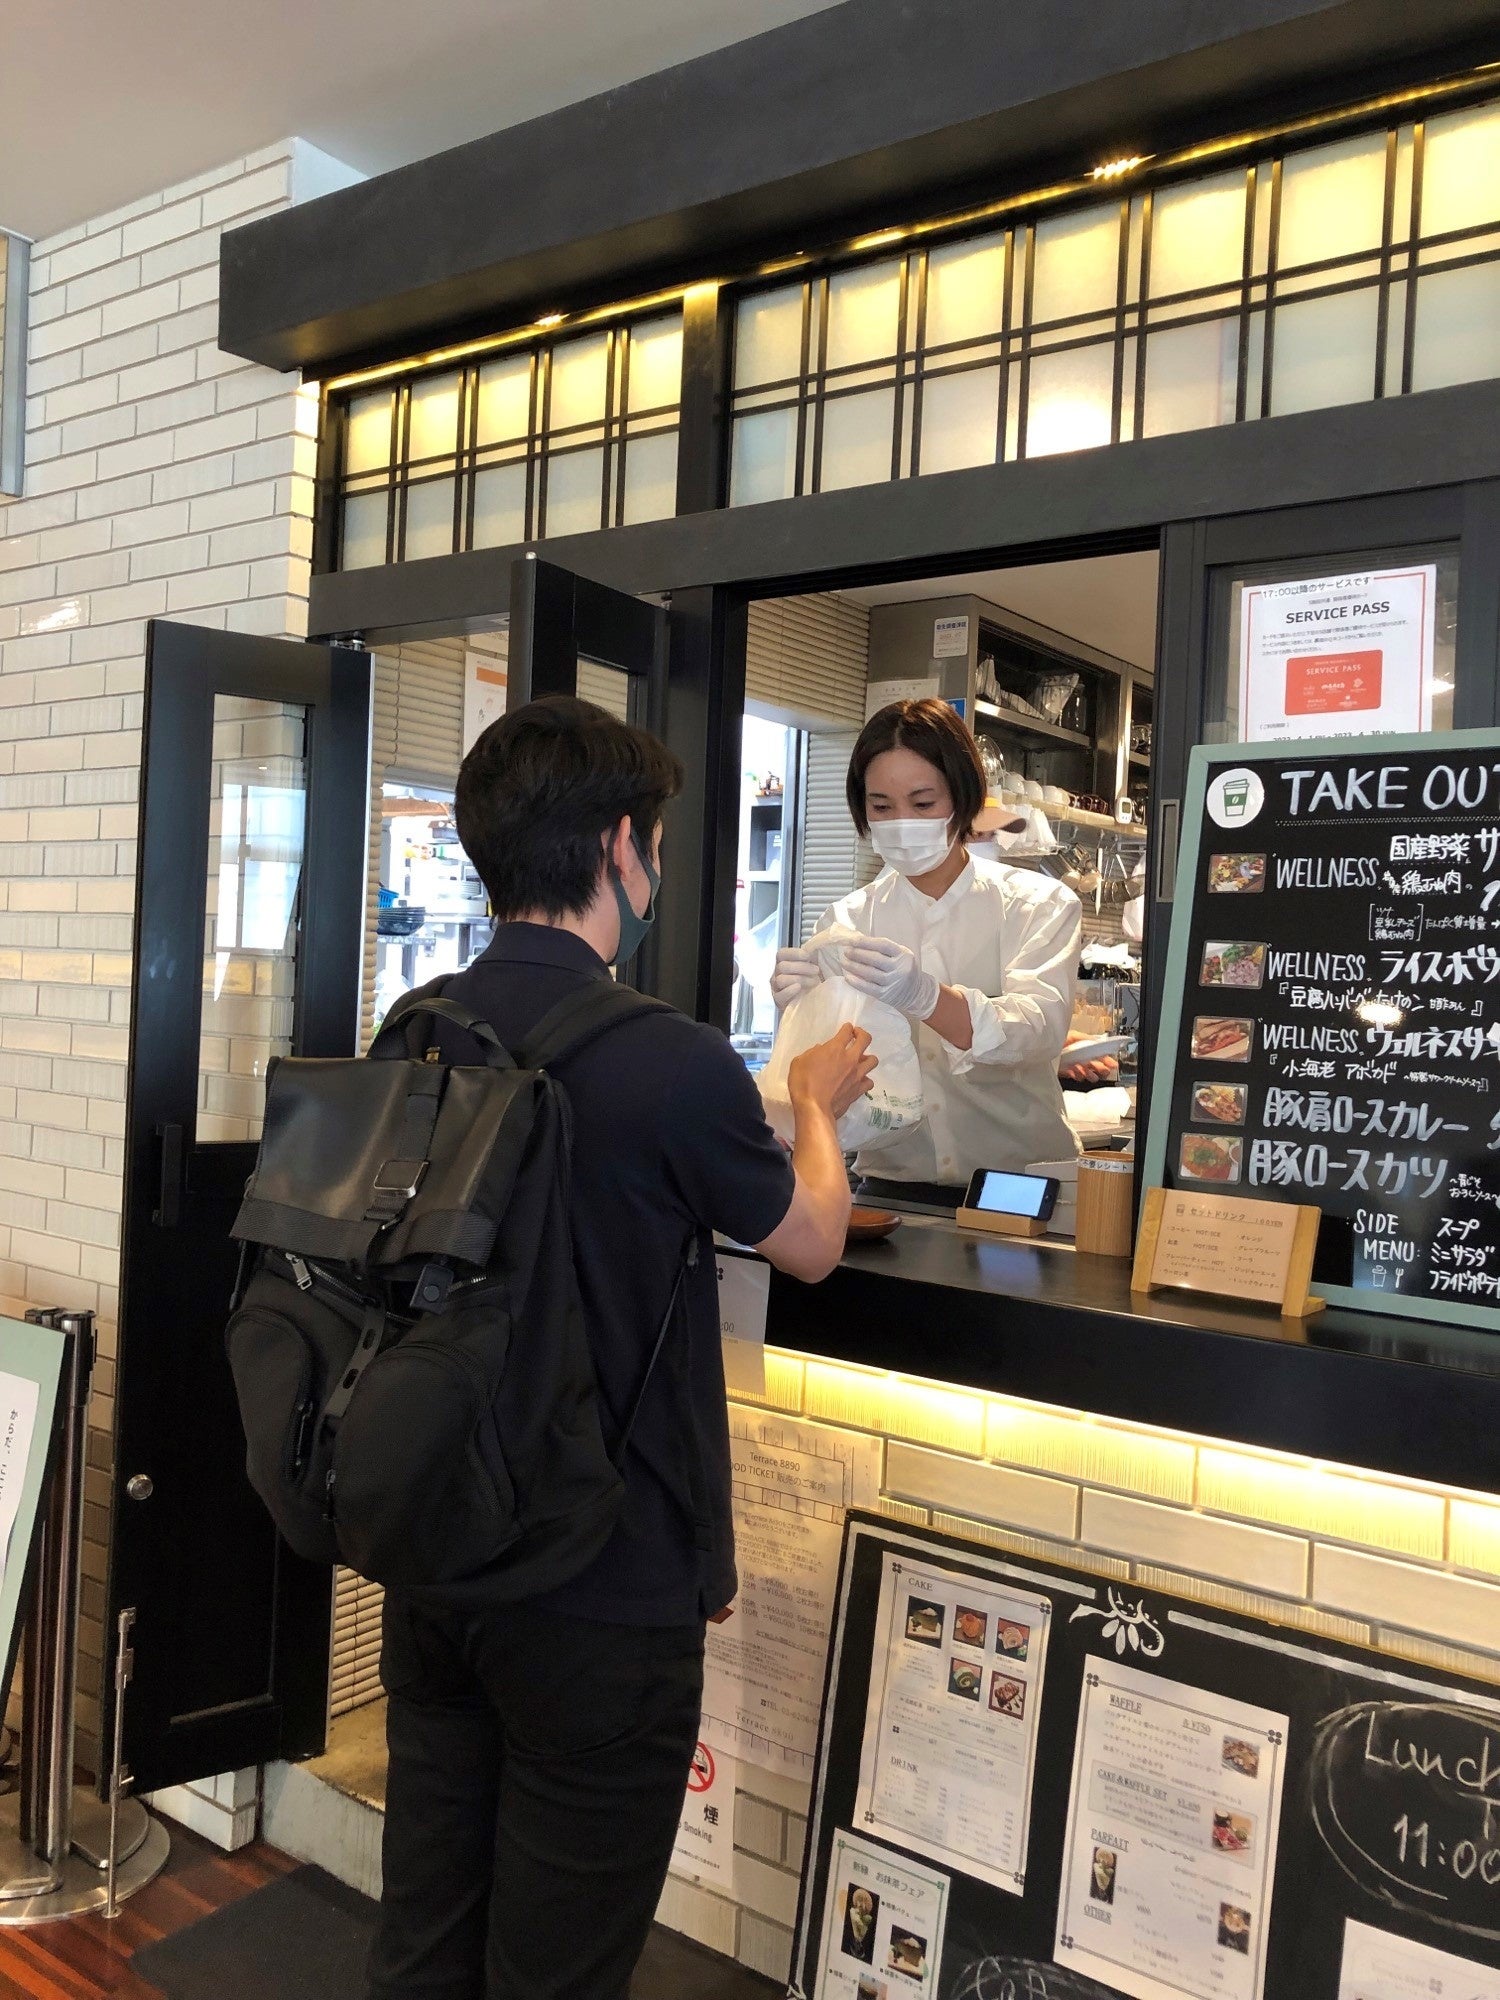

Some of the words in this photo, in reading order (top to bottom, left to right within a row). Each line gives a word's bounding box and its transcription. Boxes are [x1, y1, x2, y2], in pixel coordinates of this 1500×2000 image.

[1286, 607, 1348, 624] SERVICE
[1353, 601, 1390, 617] PASS
[1306, 665, 1339, 676] SERVICE
[1342, 664, 1362, 673] PASS
[1281, 766, 1409, 816] TAKE
[1345, 1060, 1397, 1084] アボカド
[1262, 1086, 1470, 1142] 豚肩ロースカレー
[1248, 1139, 1449, 1198] 豚ロースカツ
[1437, 1217, 1480, 1241] スープ
[1430, 1241, 1496, 1267] ミニサラダ
[749, 1465, 775, 1480] TICKET
[750, 1451, 778, 1467] Terrace
[780, 1458, 800, 1472] 8890
[908, 1576, 934, 1592] CAKE
[1109, 1693, 1143, 1713] WAFFLE
[735, 1711, 769, 1733] Terrace
[890, 1755, 919, 1775] DRINK
[703, 1803, 719, 1827] 煙
[684, 1821, 713, 1844] Smoking
[1091, 1828, 1130, 1851] PARFAIT
[1083, 1904, 1112, 1924] OTHER
